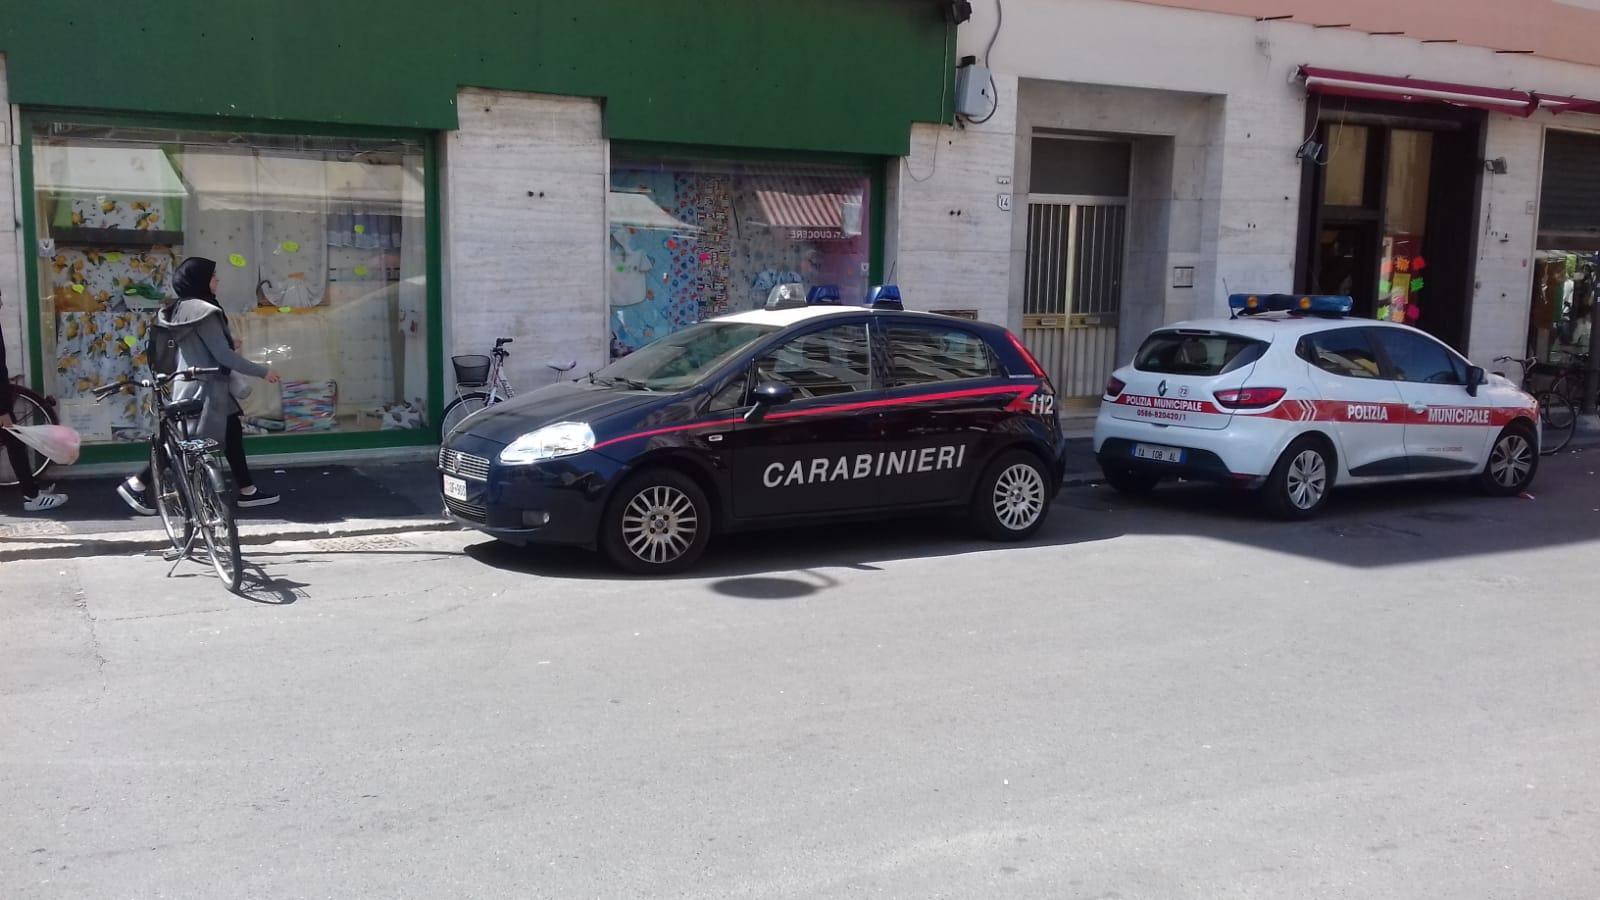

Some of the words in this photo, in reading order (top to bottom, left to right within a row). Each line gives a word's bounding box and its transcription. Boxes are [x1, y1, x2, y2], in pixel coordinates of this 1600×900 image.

[1029, 393, 1055, 415] 112
[1126, 395, 1152, 407] POLIZIA
[1153, 398, 1203, 411] MUNICIPALE
[1347, 404, 1388, 421] POLIZIA
[1427, 408, 1489, 424] MUNICIPALE
[762, 444, 966, 488] CARABINIERI
